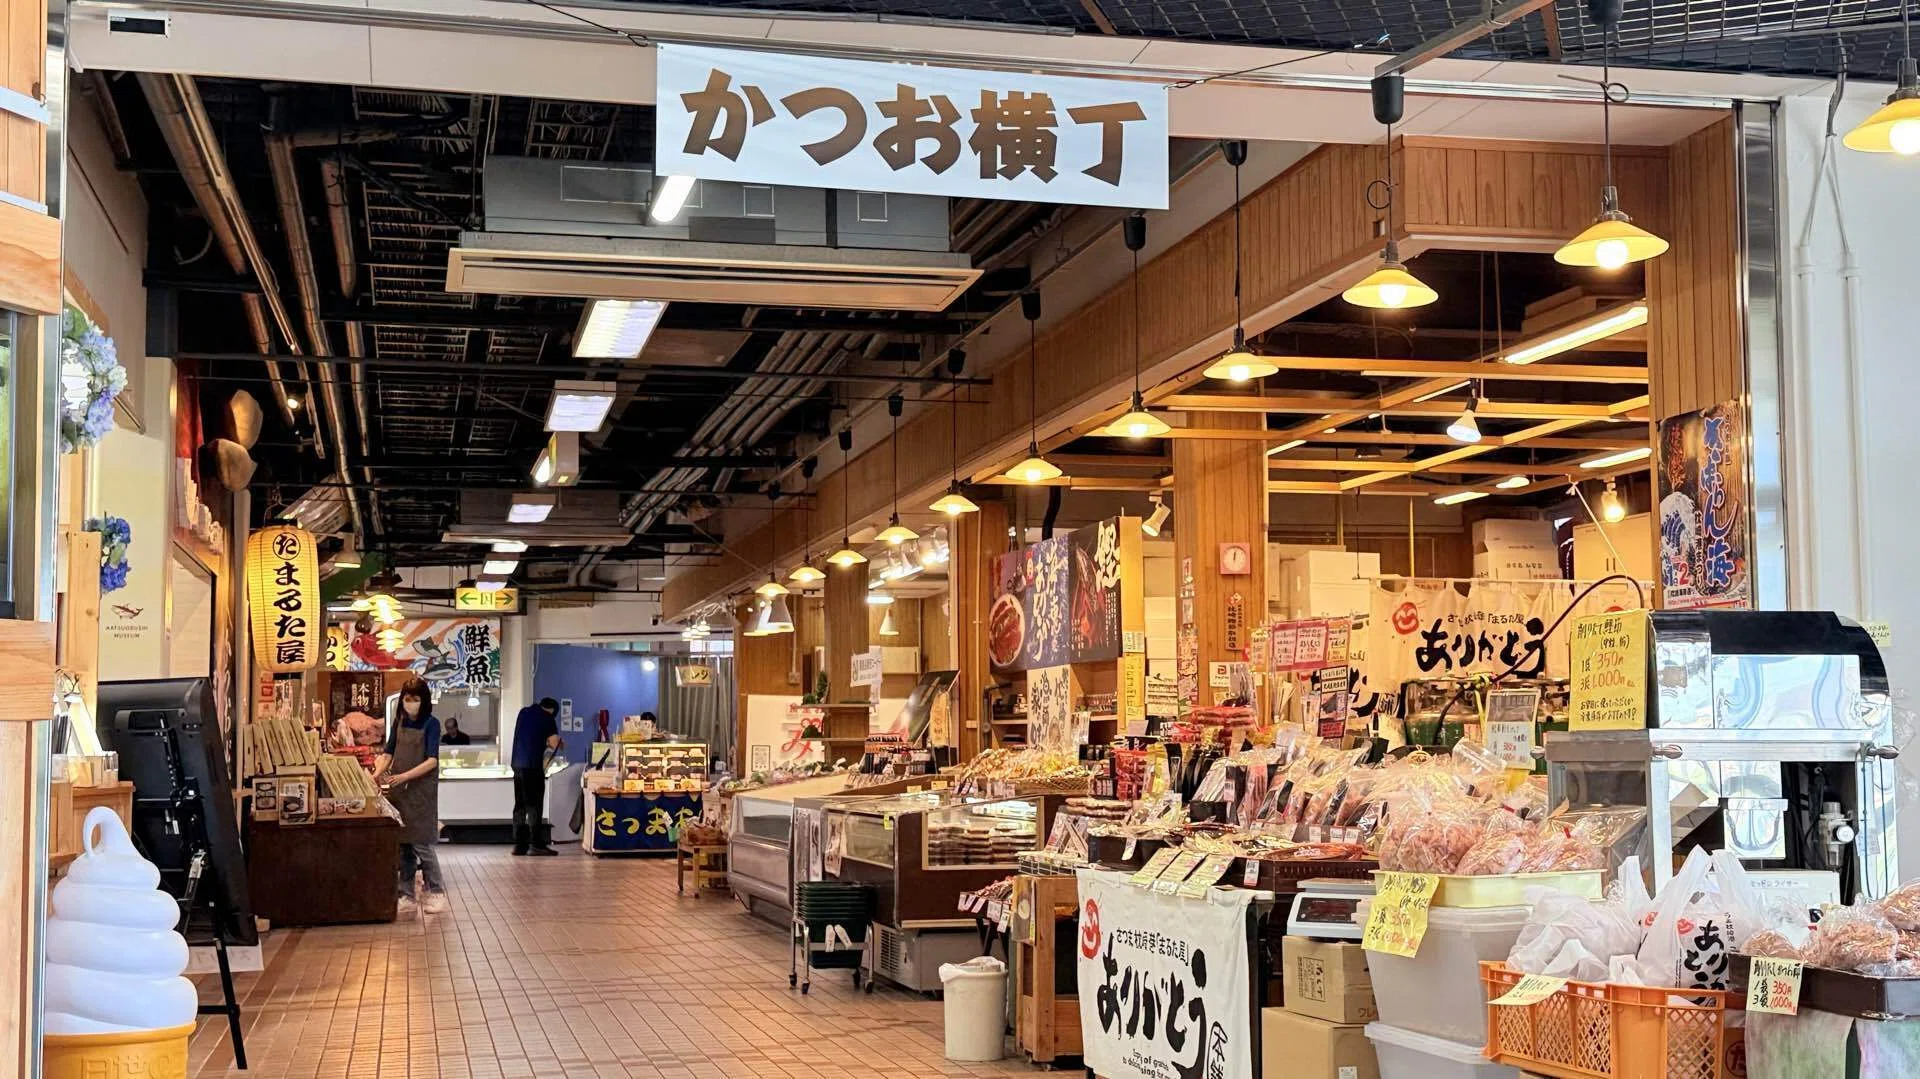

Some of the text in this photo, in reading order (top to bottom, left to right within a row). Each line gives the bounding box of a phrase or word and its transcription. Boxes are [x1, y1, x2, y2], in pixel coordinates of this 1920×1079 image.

[680, 68, 1147, 187] かつお横丁
[273, 561, 306, 665] まるた屋
[465, 624, 490, 684] 鮮魚
[1415, 616, 1546, 679] ありがとう
[596, 807, 704, 837] さつま
